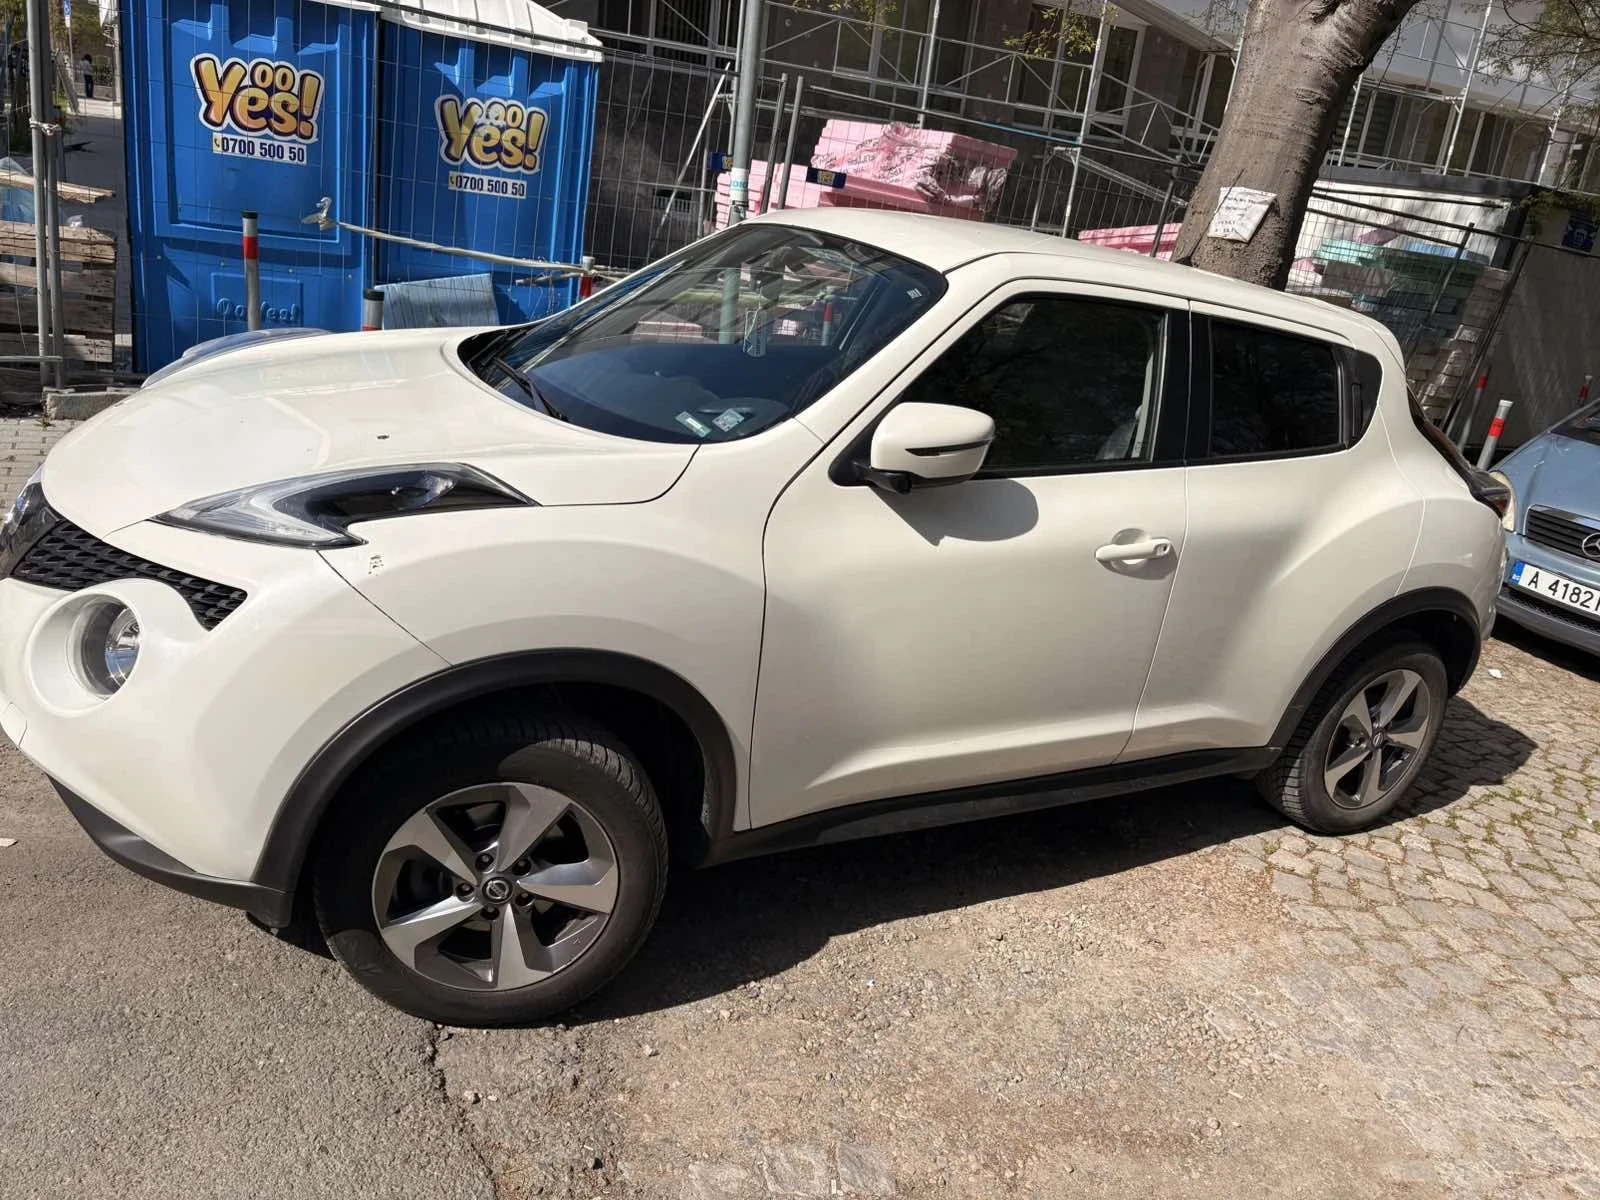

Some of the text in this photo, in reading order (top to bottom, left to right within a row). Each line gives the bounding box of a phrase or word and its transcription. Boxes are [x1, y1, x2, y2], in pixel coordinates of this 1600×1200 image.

[221, 136, 305, 163] 0700 500 50
[455, 175, 525, 197] 0700 500 50
[1527, 571, 1600, 612] A 4182
